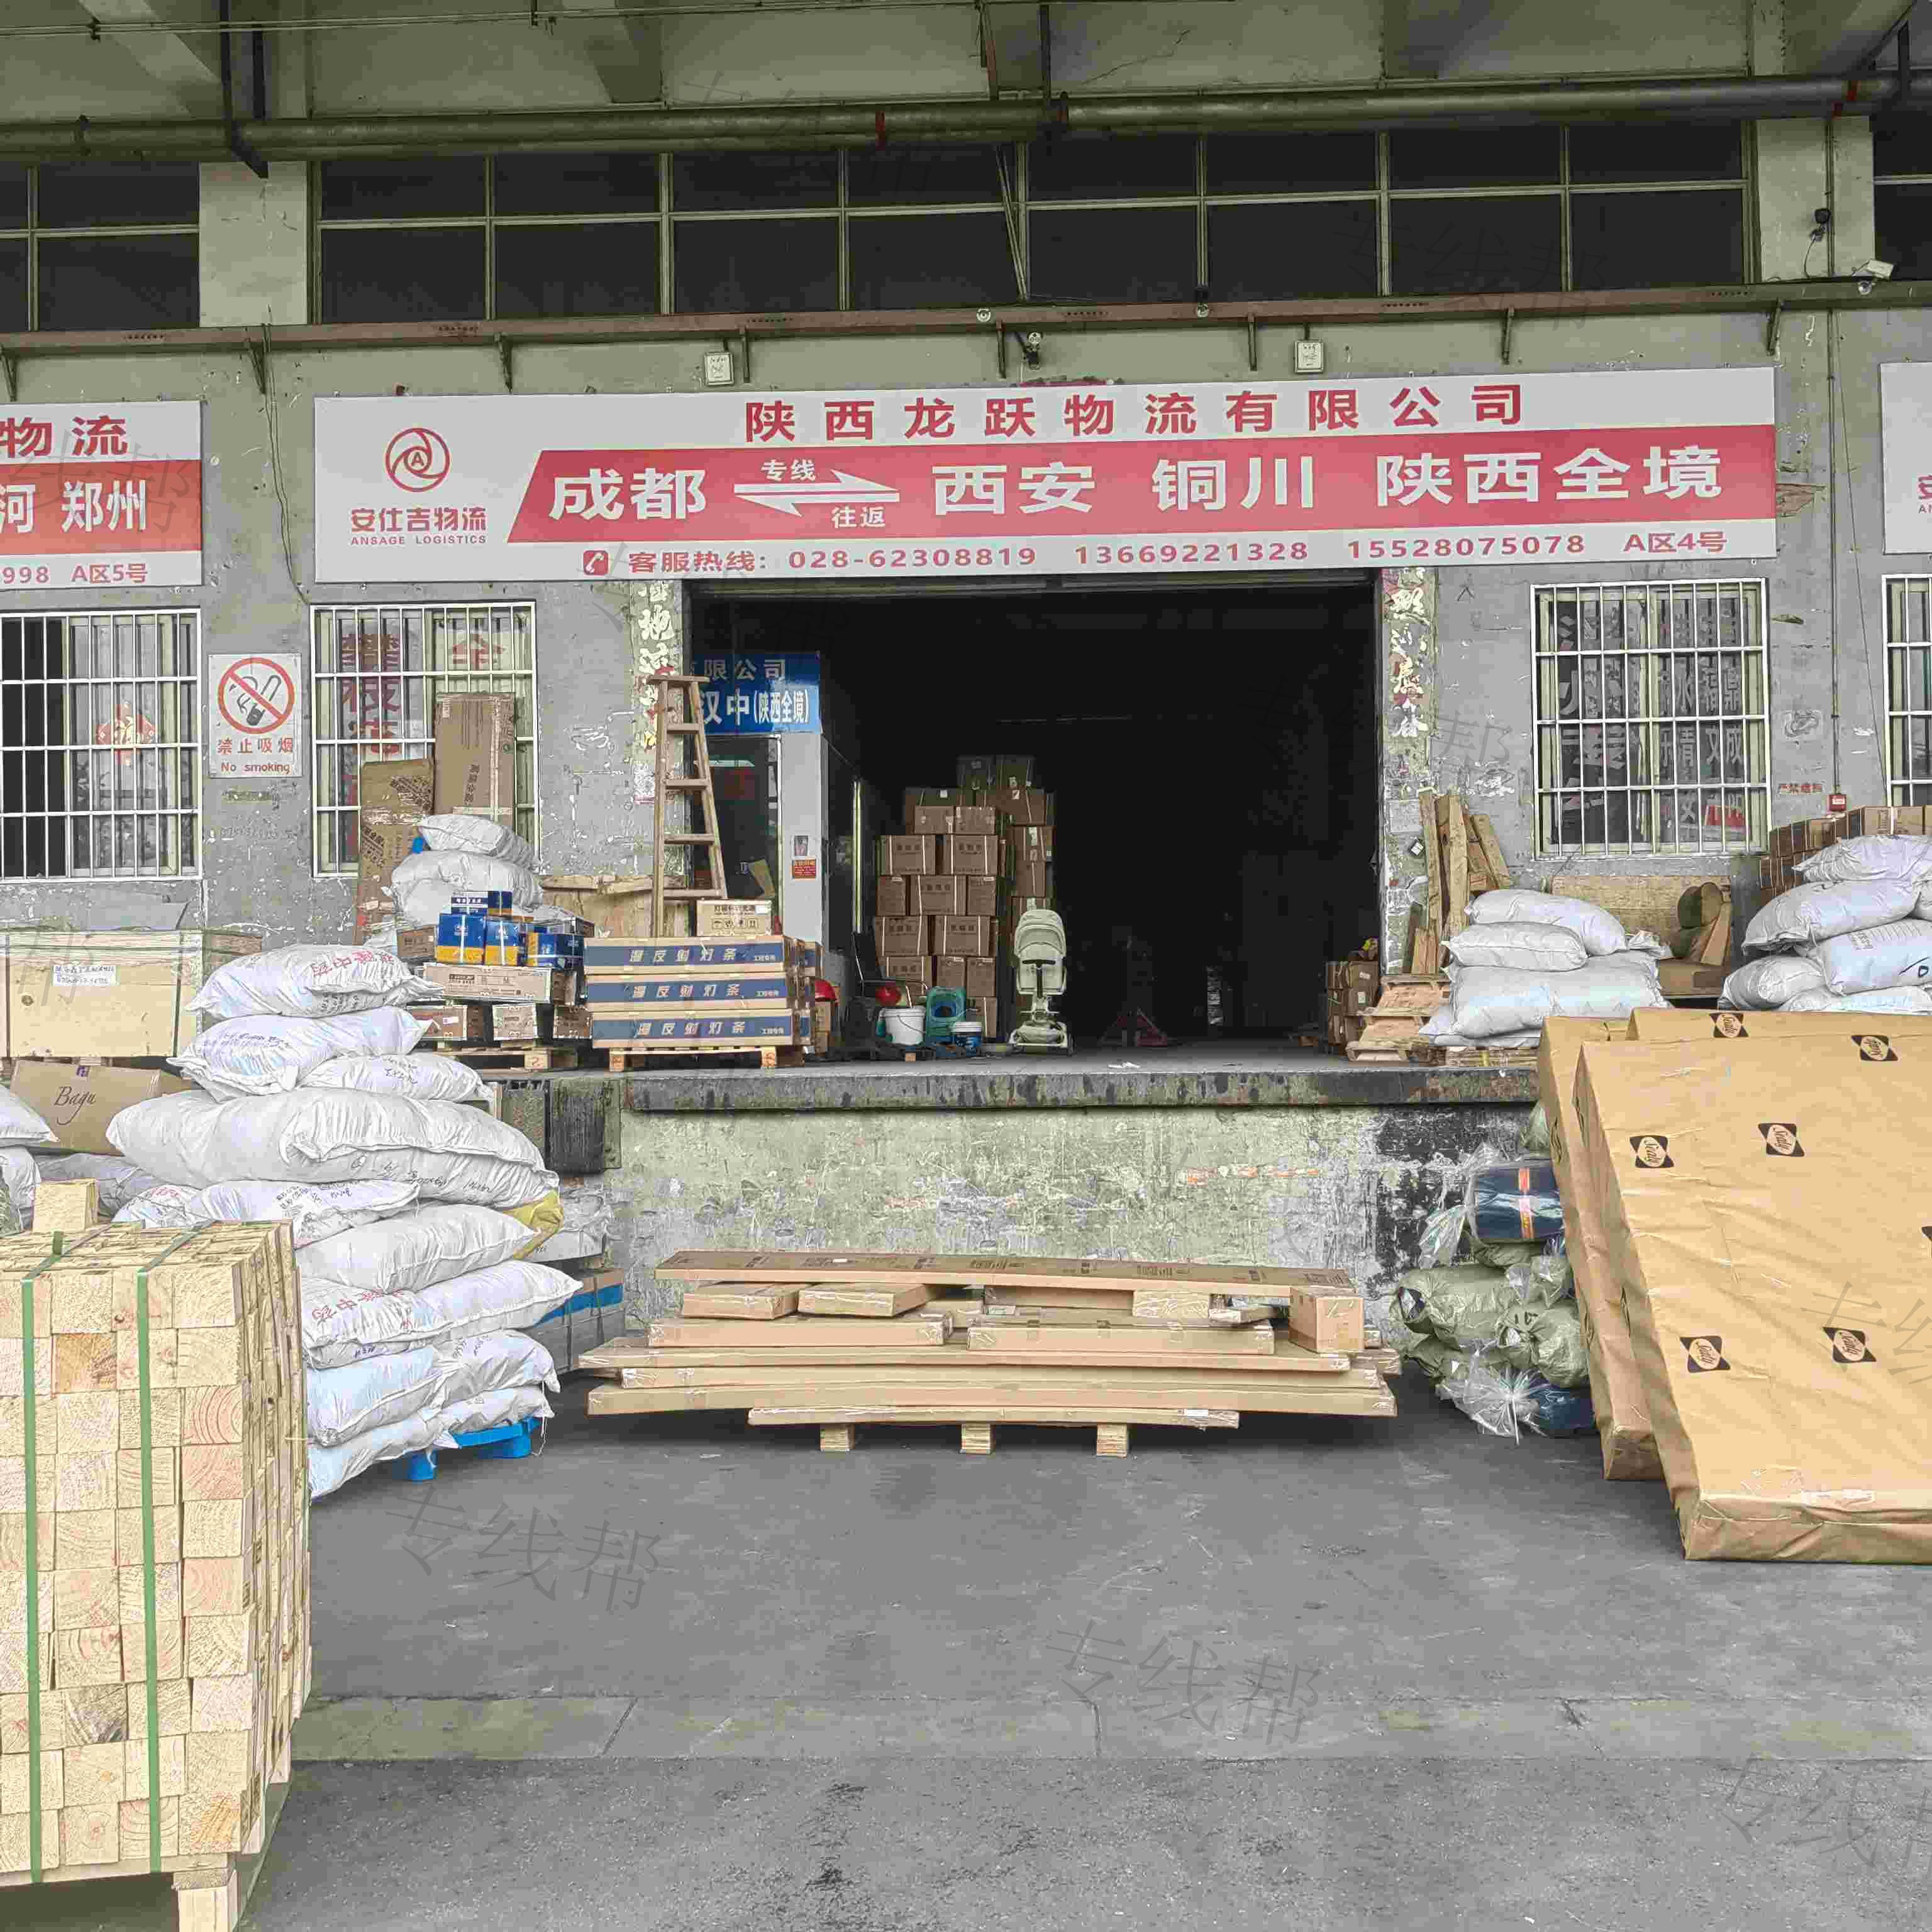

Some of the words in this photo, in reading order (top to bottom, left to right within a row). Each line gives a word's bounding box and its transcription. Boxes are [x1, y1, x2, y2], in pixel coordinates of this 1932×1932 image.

[746, 384, 1521, 443] 陕西龙跃物流有限公司
[0, 415, 128, 458] 物流
[761, 460, 816, 481] 专线
[549, 468, 706, 520] 成都
[932, 463, 1095, 515] 西安
[1152, 456, 1314, 511] 铜川
[1377, 447, 1722, 507] 陕西全境
[62, 480, 146, 532] 郑州
[831, 506, 886, 529] 往返
[352, 507, 486, 532] 安仕吉物流
[351, 536, 405, 545] ANSAGE
[416, 536, 486, 544] LOGISTICS
[789, 548, 1036, 569] 028-62308819
[1076, 542, 1308, 564] 13669221328
[1350, 535, 1584, 558] 15528075078
[1623, 533, 1727, 553] A区4号
[71, 563, 148, 584] A区5号
[218, 738, 293, 755] 禁止吸烟
[221, 762, 236, 772] No
[244, 762, 291, 774] smoking
